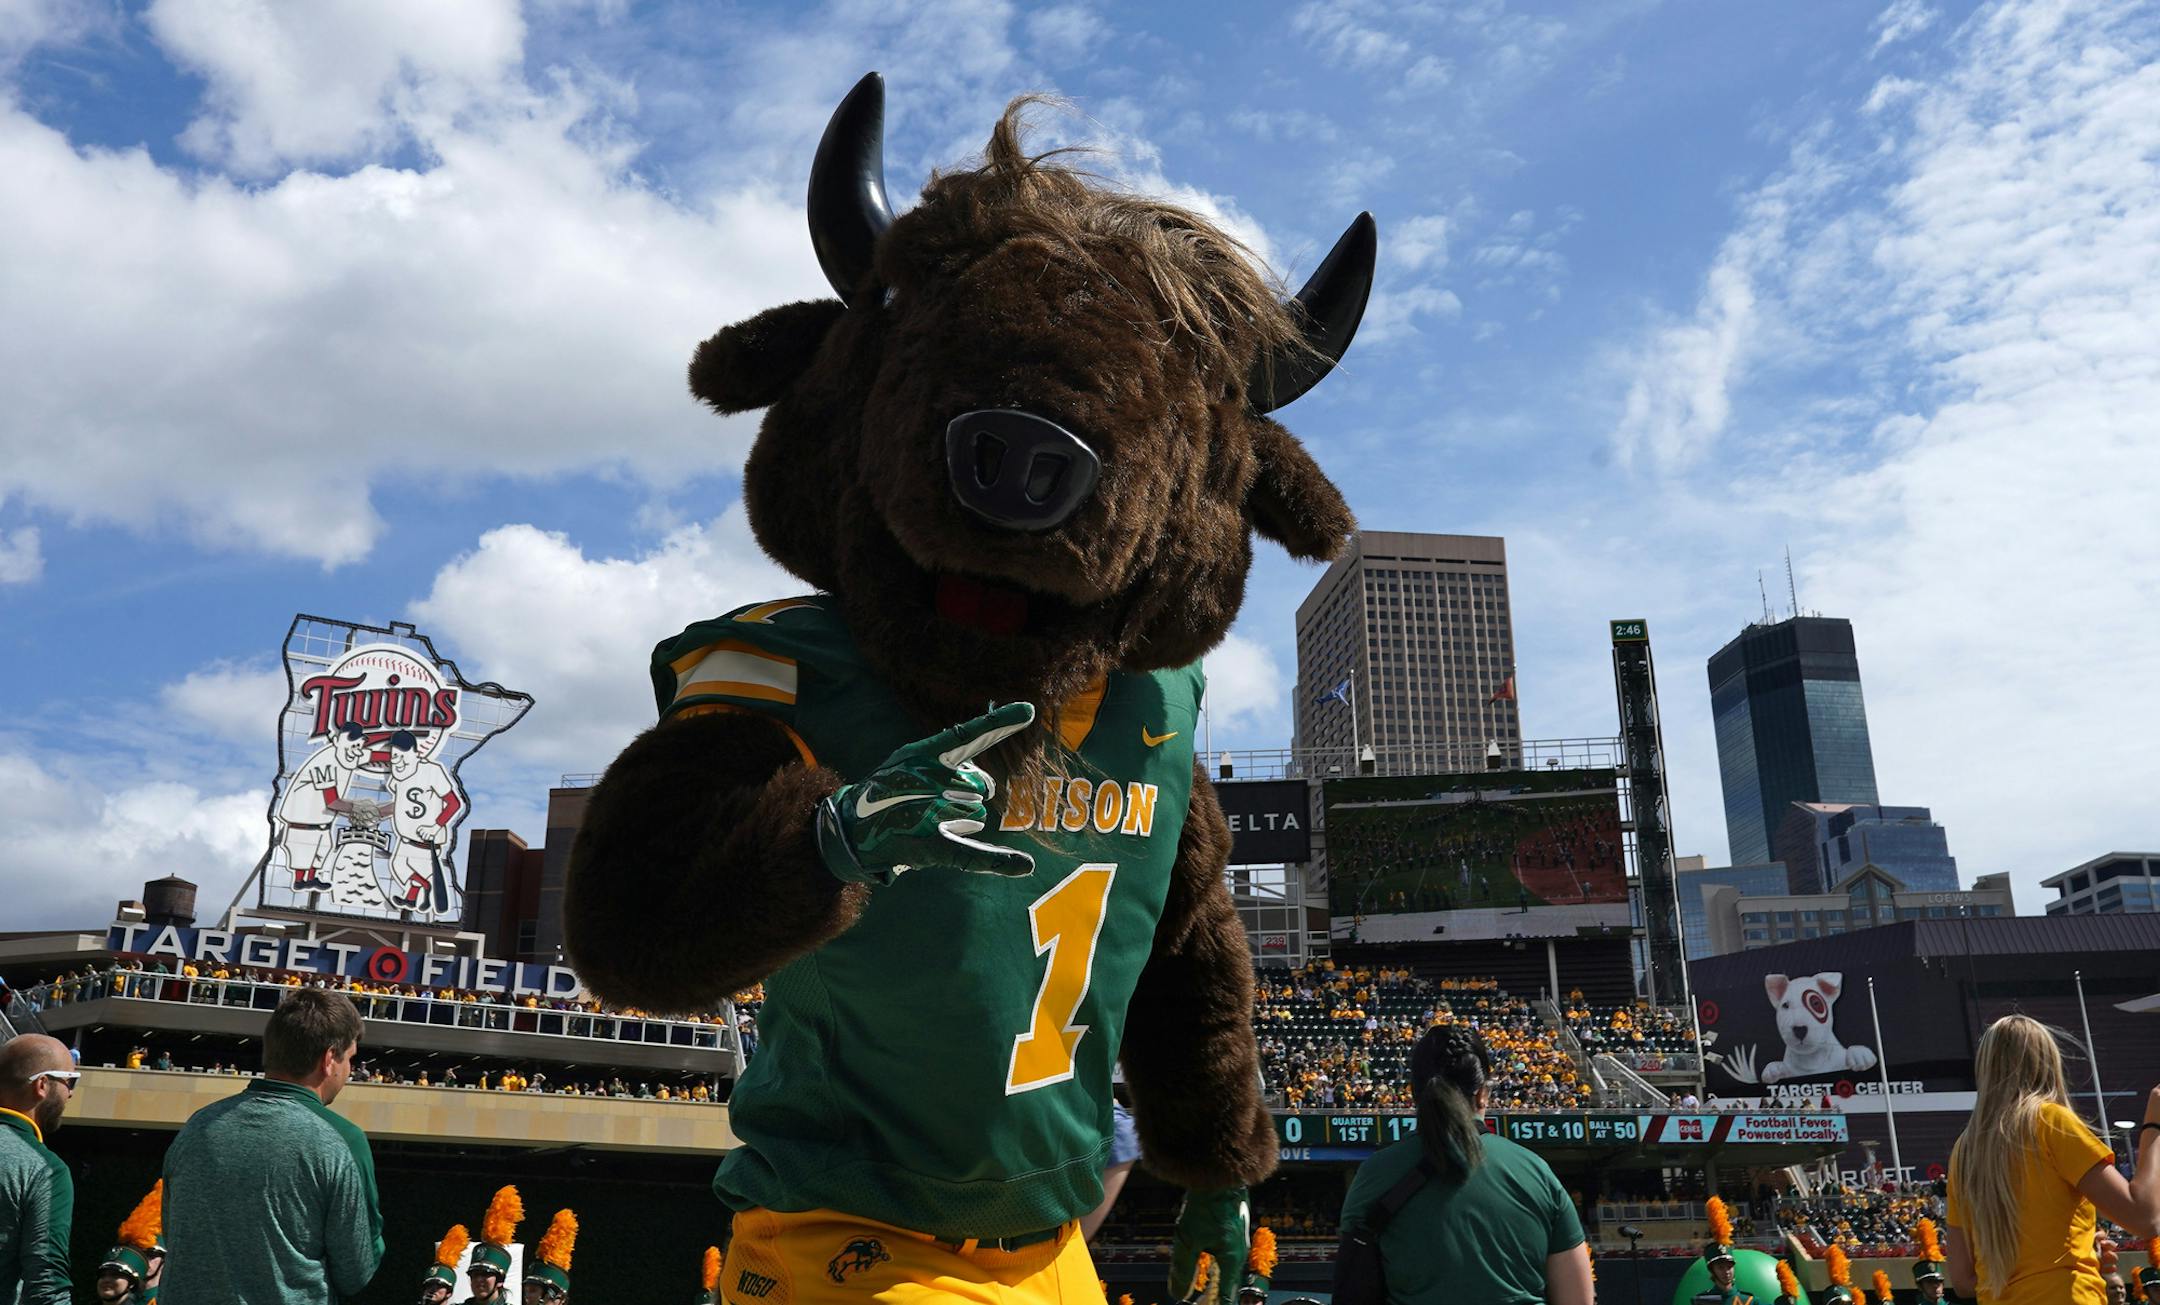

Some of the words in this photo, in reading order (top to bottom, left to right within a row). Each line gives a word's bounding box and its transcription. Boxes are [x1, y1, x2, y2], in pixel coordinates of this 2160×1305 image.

[1615, 624, 1641, 636] 2:46
[301, 671, 459, 739] Twins
[999, 775, 1159, 838] BISON
[1228, 813, 1300, 832] ELTA
[1927, 893, 1972, 904] LOEWS
[110, 921, 361, 977] TARGET
[420, 952, 580, 998] FIELD
[1004, 862, 1118, 1097] 1
[1766, 1083, 1834, 1097] TARGET
[1331, 1117, 1374, 1126] QUARTER
[1589, 1120, 1612, 1129] BALL
[1745, 1117, 1796, 1127] Football
[1800, 1117, 1836, 1127] Fever.
[1285, 1117, 1302, 1142] 0
[1340, 1127, 1369, 1142] 1ST
[1511, 1121, 1545, 1139] 1ST
[1548, 1124, 1559, 1137] &
[1562, 1121, 1584, 1139] 10
[1595, 1129, 1607, 1138] AT
[1614, 1121, 1637, 1139] 50
[1738, 1128, 1792, 1139] Powered
